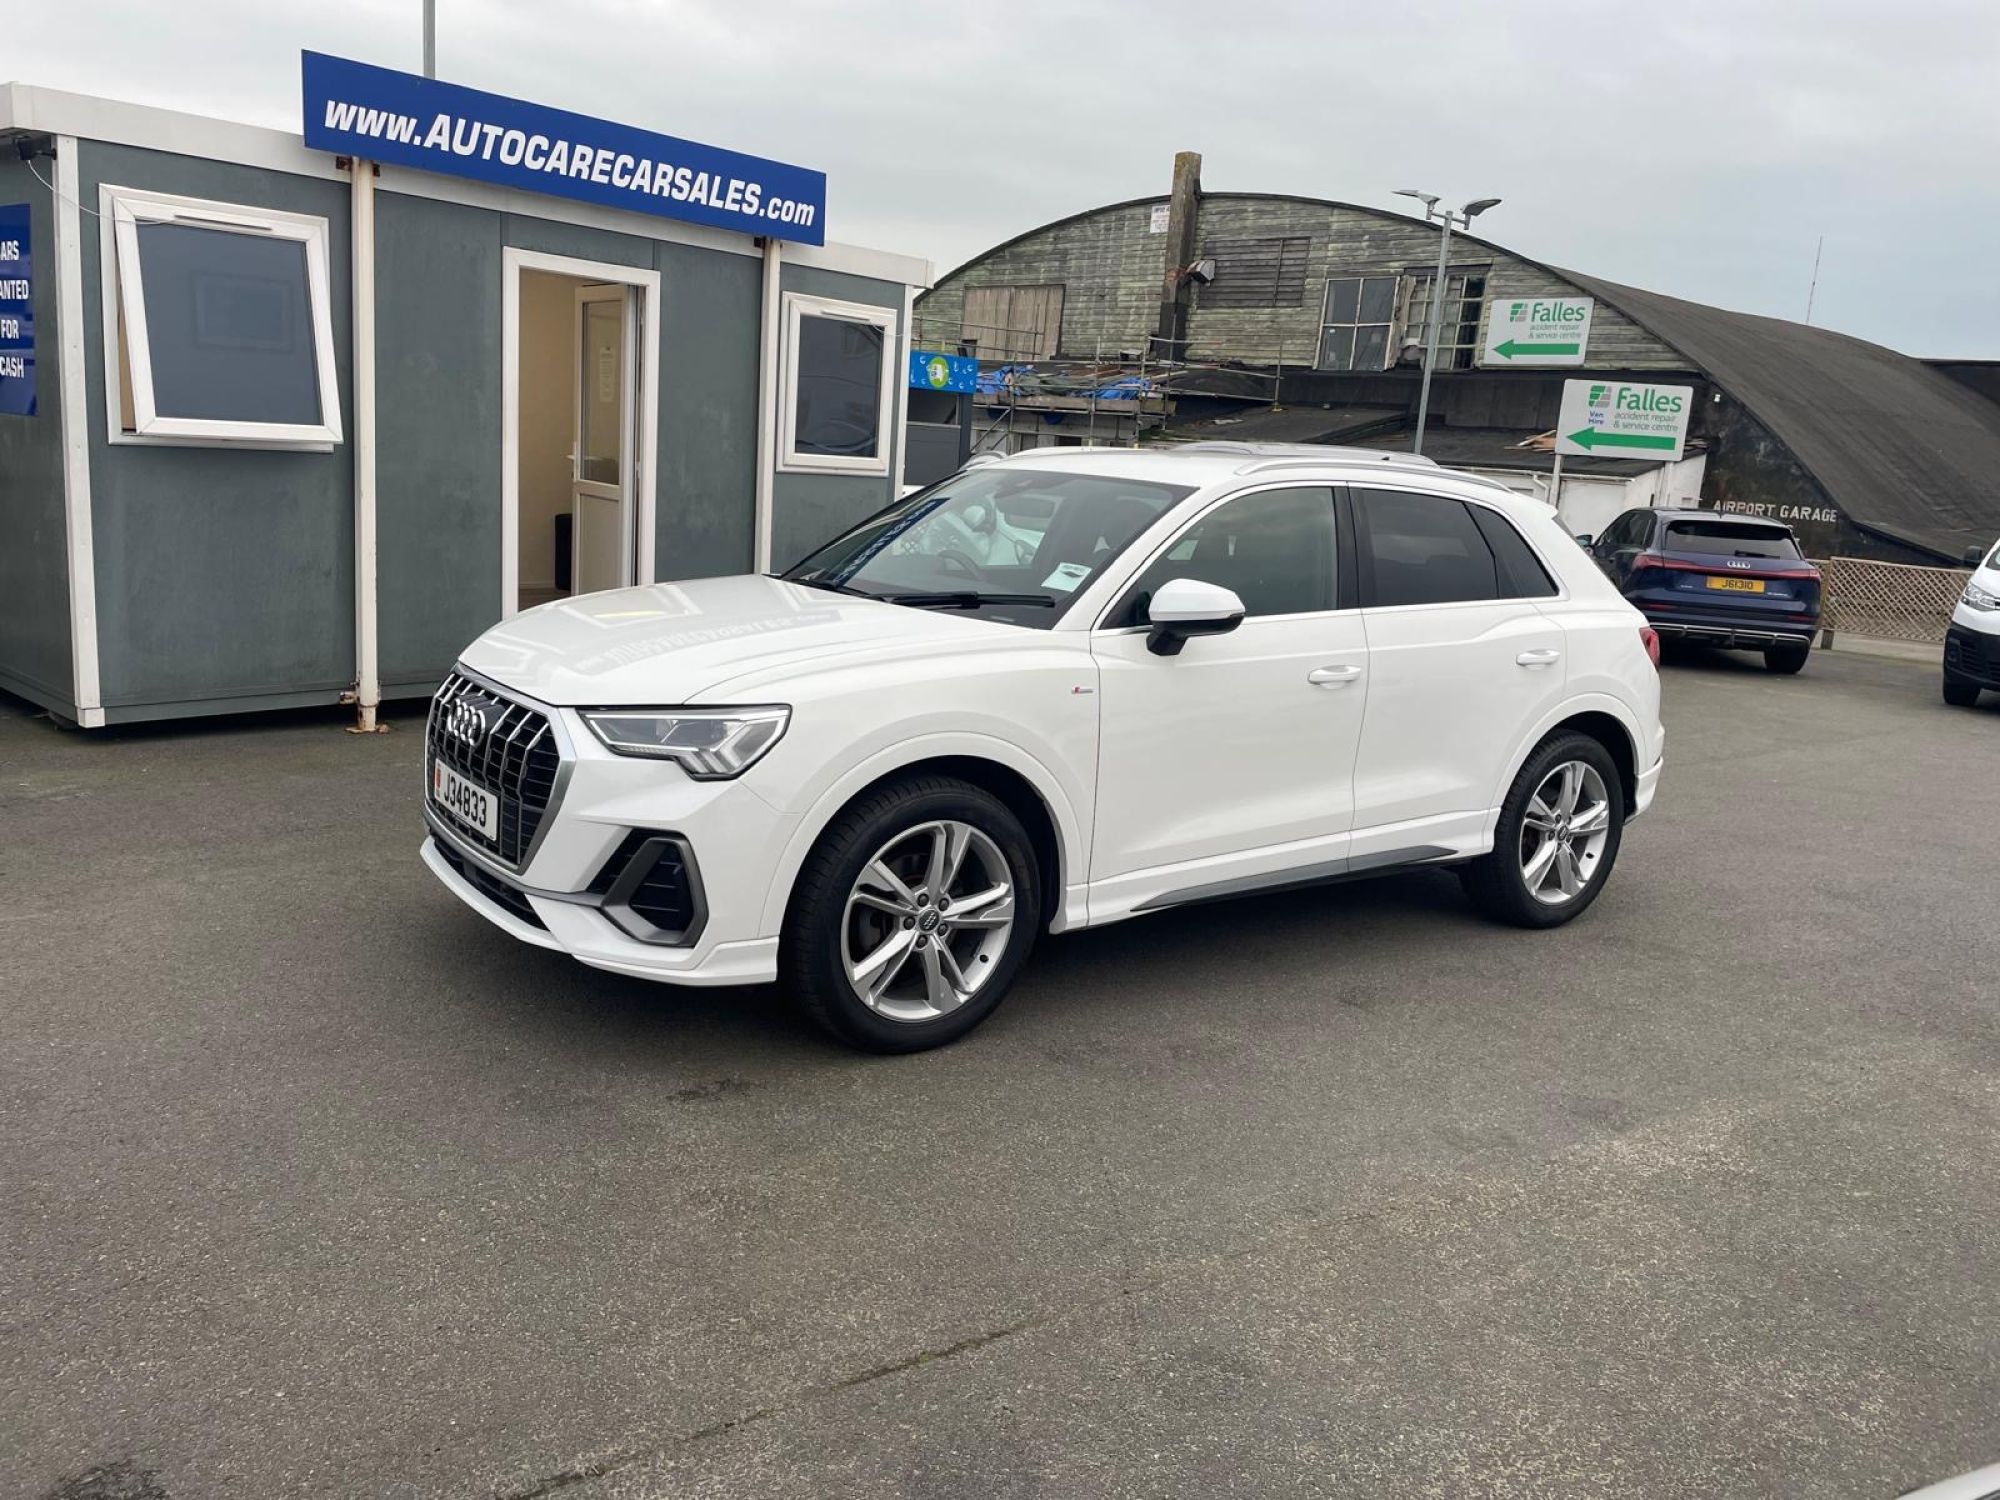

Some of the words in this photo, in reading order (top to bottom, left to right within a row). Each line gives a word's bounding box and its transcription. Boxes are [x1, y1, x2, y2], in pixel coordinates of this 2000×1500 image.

[324, 100, 815, 227] www.AUTOCARECARSALES.com
[0, 240, 20, 261] ARS
[0, 279, 29, 300] ANTED
[1531, 302, 1585, 322] Falles
[1, 319, 20, 339] FOR
[0, 356, 25, 378] CASH
[1616, 387, 1683, 413] Falles
[1615, 411, 1649, 420] accident
[1652, 414, 1676, 422] repair
[1622, 421, 1650, 430] service
[1651, 423, 1679, 431] centre
[1713, 500, 1776, 516] AIRPORT
[1780, 505, 1837, 522] GARAGE
[444, 773, 487, 827] J34833
